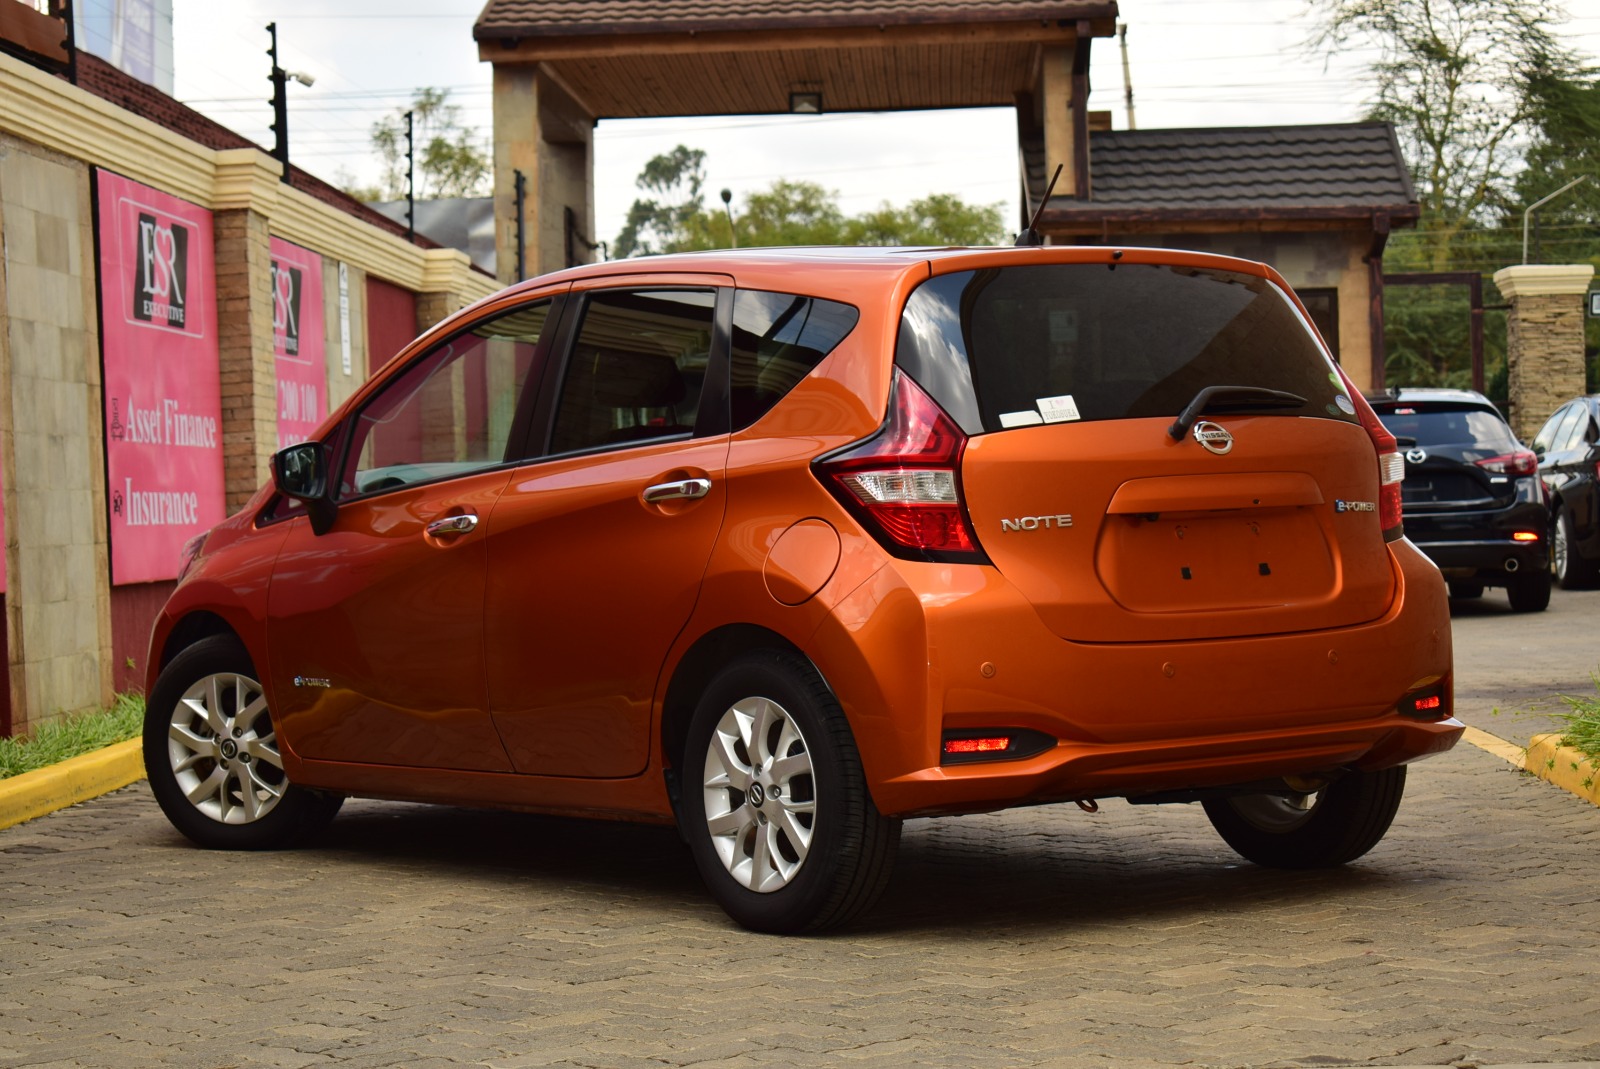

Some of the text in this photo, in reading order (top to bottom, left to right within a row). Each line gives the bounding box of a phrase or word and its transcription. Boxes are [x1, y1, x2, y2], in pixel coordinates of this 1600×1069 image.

[140, 221, 183, 304] ESR
[143, 300, 184, 323] EXECUTIVE
[125, 395, 217, 449] Asset Finance
[280, 379, 318, 424] 200 100
[125, 477, 198, 526] Insurance
[1001, 514, 1073, 532] NOTE
